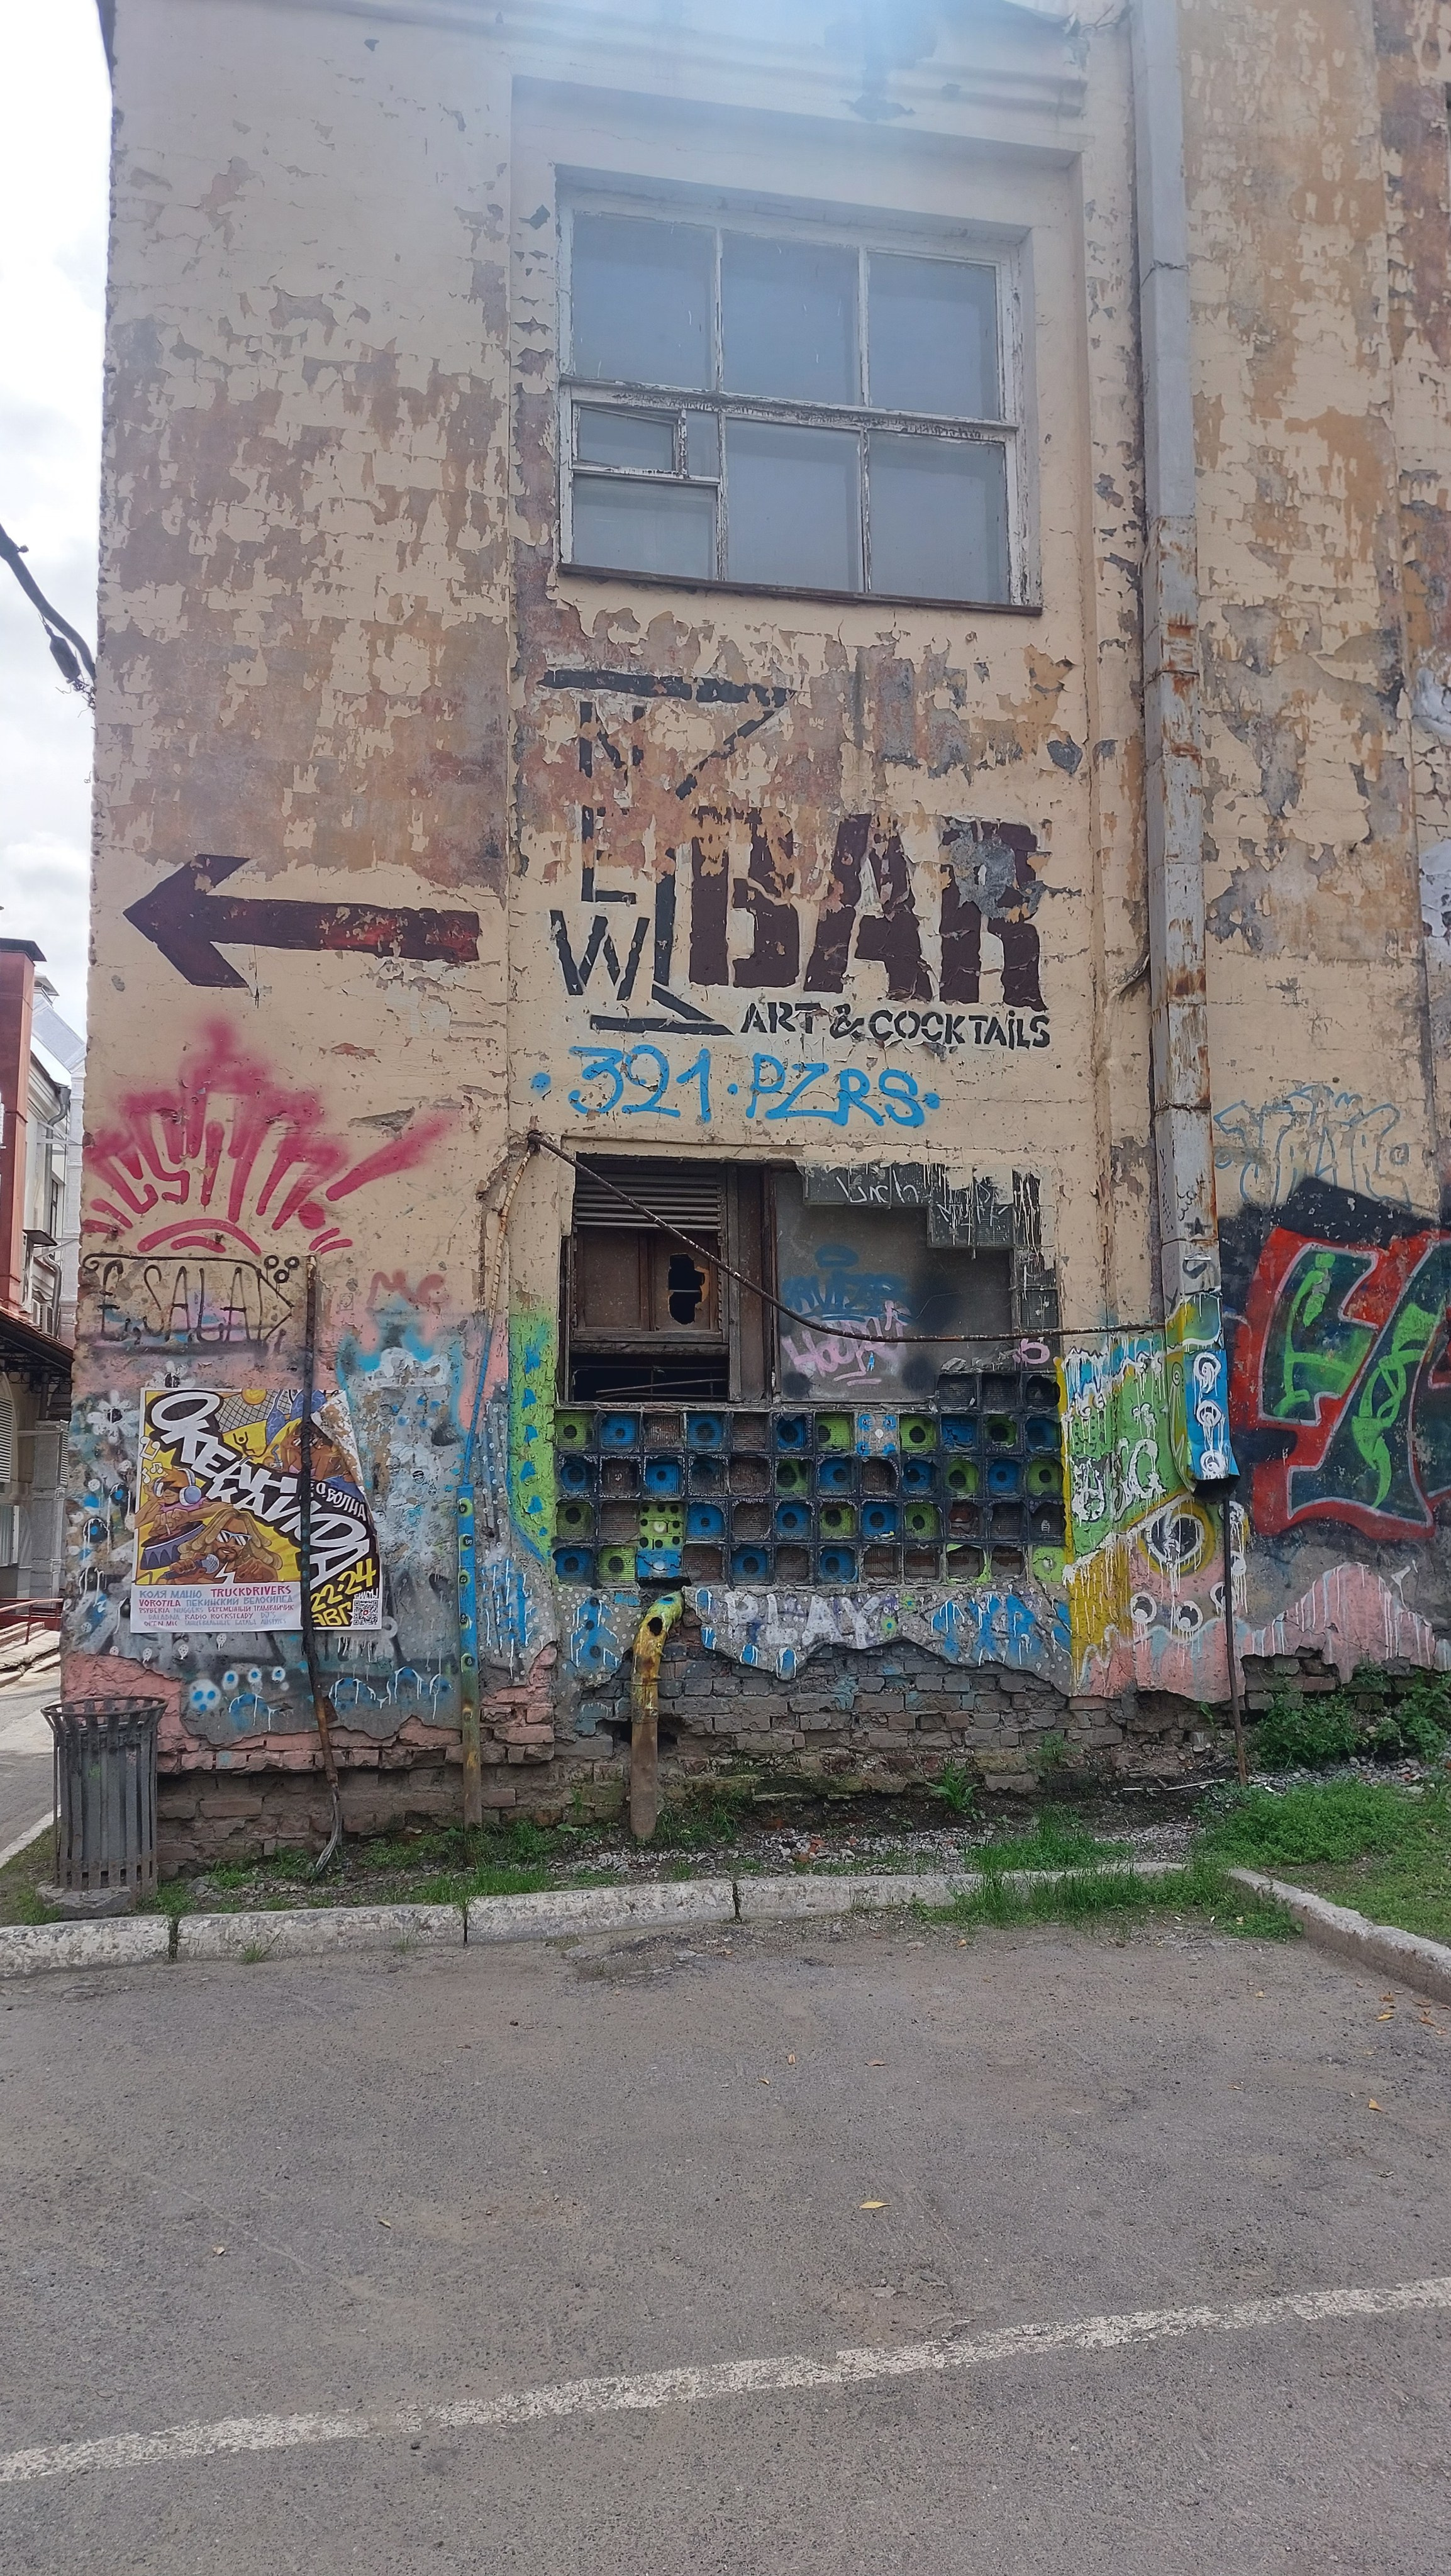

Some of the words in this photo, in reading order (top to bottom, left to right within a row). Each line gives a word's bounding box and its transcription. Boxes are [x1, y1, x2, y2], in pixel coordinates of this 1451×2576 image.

[689, 806, 1048, 1011] BAR
[740, 1002, 821, 1035] ART
[830, 1003, 865, 1041] &
[139, 1590, 167, 1599] КОЛЯ
[211, 1585, 292, 1597] TRUCKDRIVERS
[139, 1599, 181, 1607] VOROTILA
[186, 1597, 240, 1607] ПЕКИНСКИЙ
[243, 1595, 294, 1605] ВЕЛОСИПЕД
